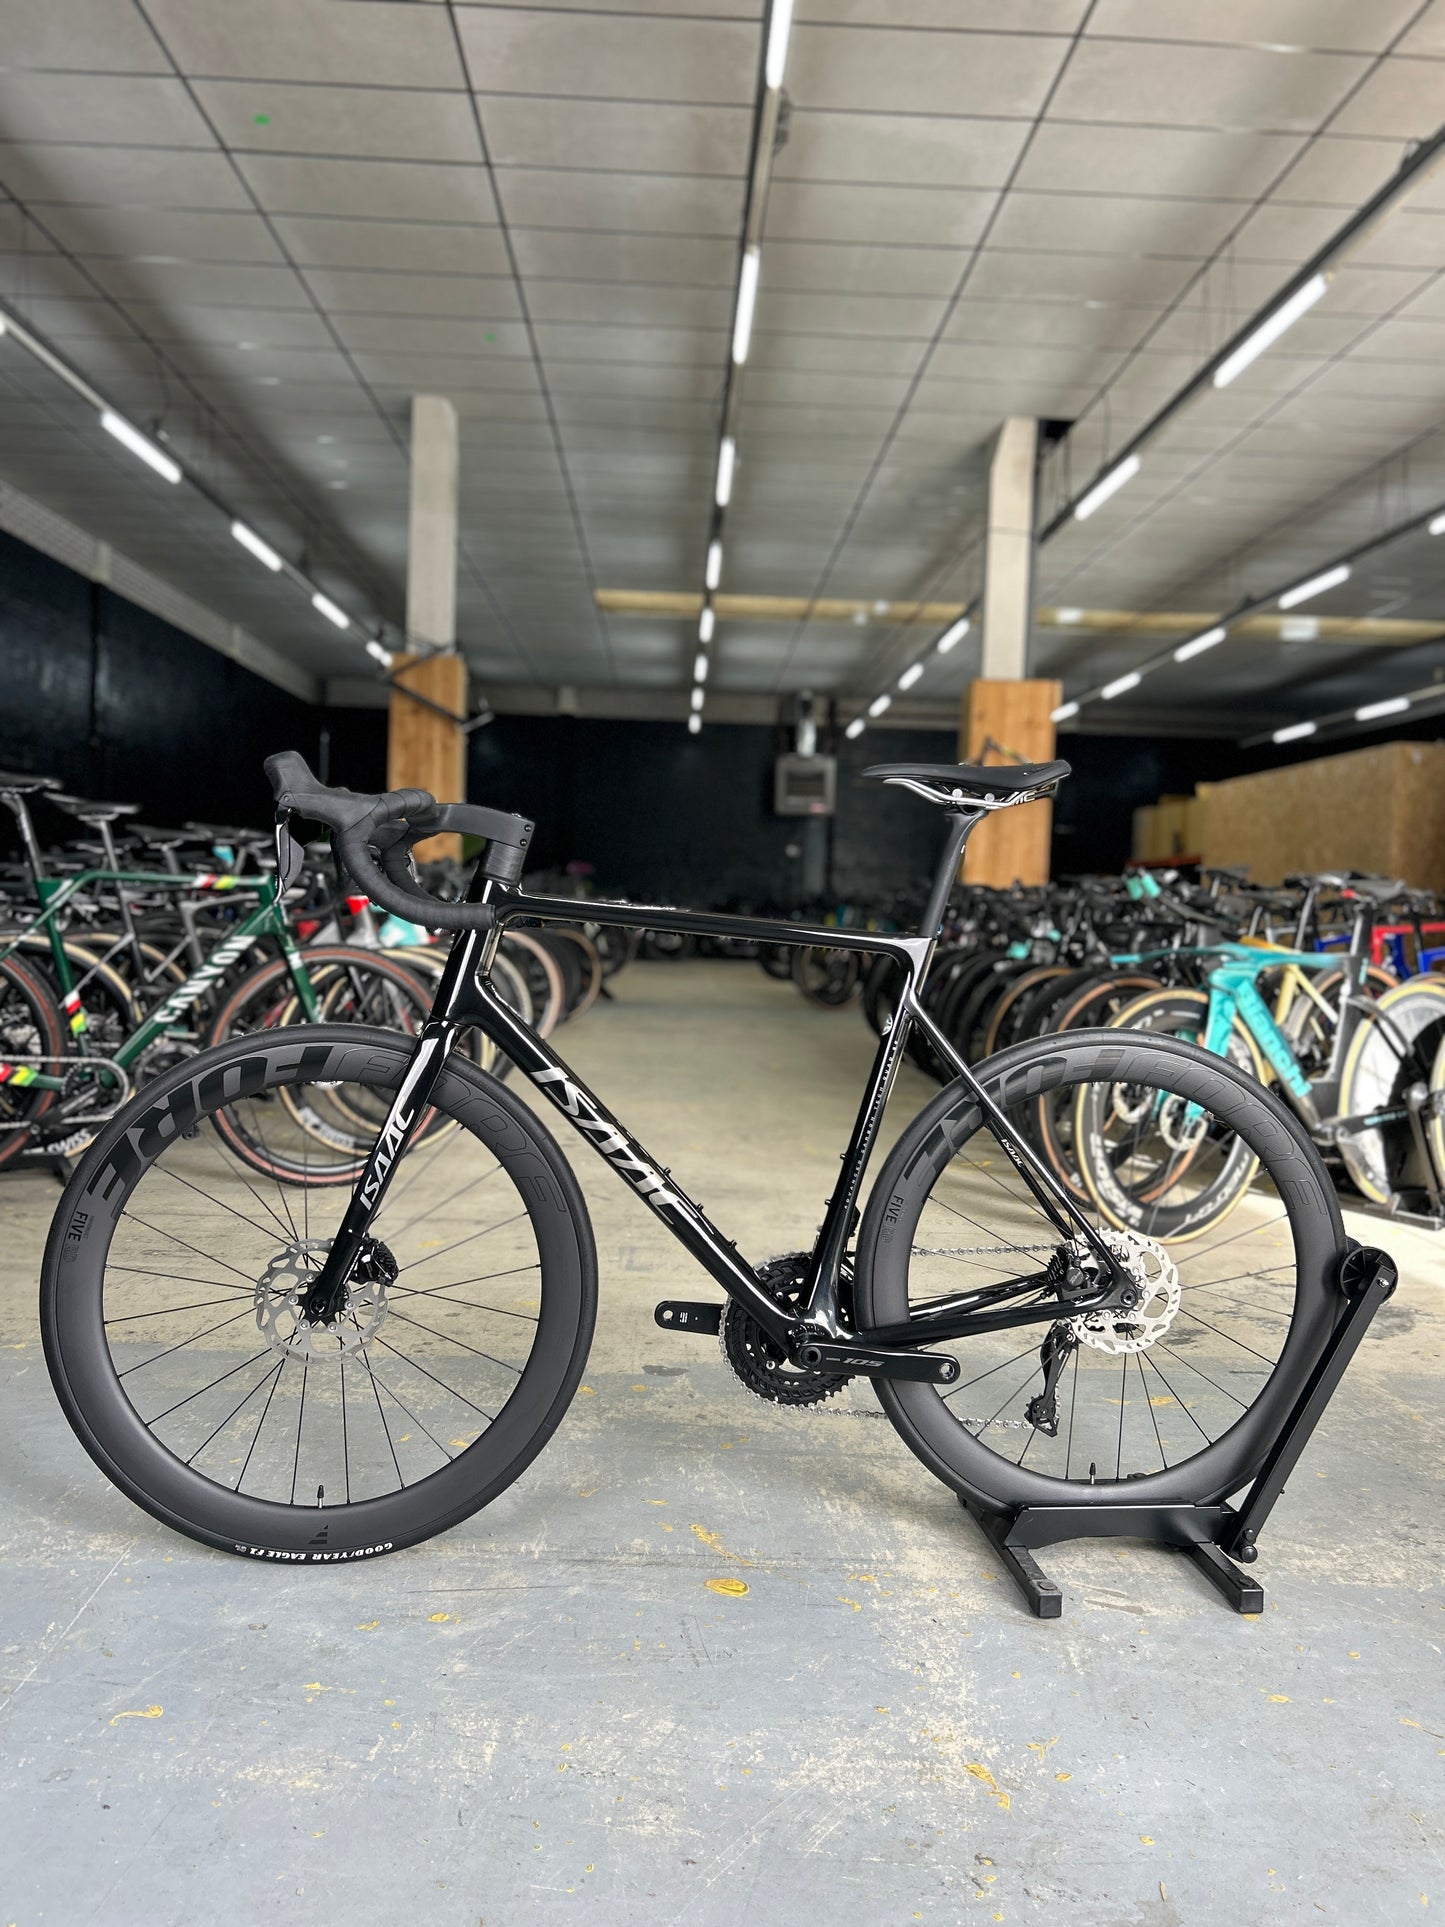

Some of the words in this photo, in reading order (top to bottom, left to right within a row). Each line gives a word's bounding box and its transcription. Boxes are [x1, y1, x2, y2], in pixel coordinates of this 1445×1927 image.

[153, 935, 257, 1023] CANYON
[359, 1096, 415, 1211] ISAAC
[530, 1067, 700, 1225] ISAAC
[1001, 1138, 1025, 1168] ISAAC
[844, 1160, 862, 1210] ADVANCED
[885, 1195, 905, 1224] FIVE
[67, 1211, 89, 1242] FIVE
[842, 1357, 885, 1368] 105
[267, 1550, 306, 1560] EAGLE
